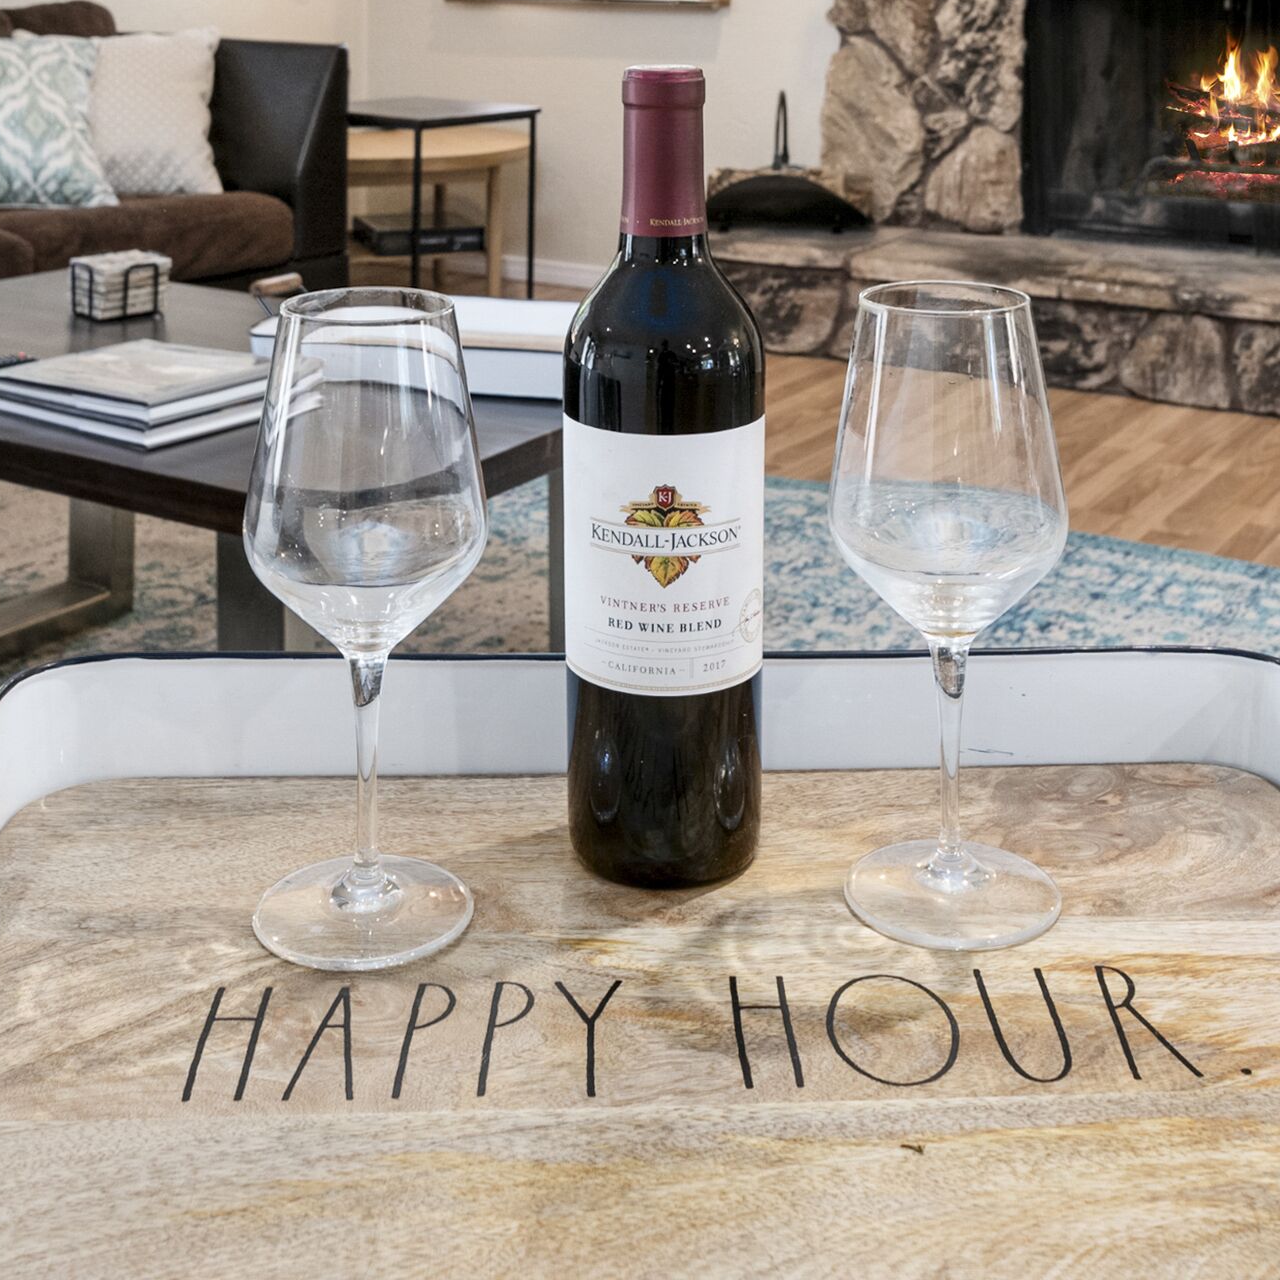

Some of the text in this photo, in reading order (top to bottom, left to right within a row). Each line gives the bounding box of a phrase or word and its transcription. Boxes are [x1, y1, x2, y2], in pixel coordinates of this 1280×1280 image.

[591, 522, 739, 552] KENDALL-JACKSON
[600, 595, 730, 613] VINTNER'S RESERVE
[608, 617, 722, 633] RED WINE BLEND
[608, 659, 727, 676] CALIFORNIA 2017
[181, 965, 1253, 1102] HAPPY HOUR.
